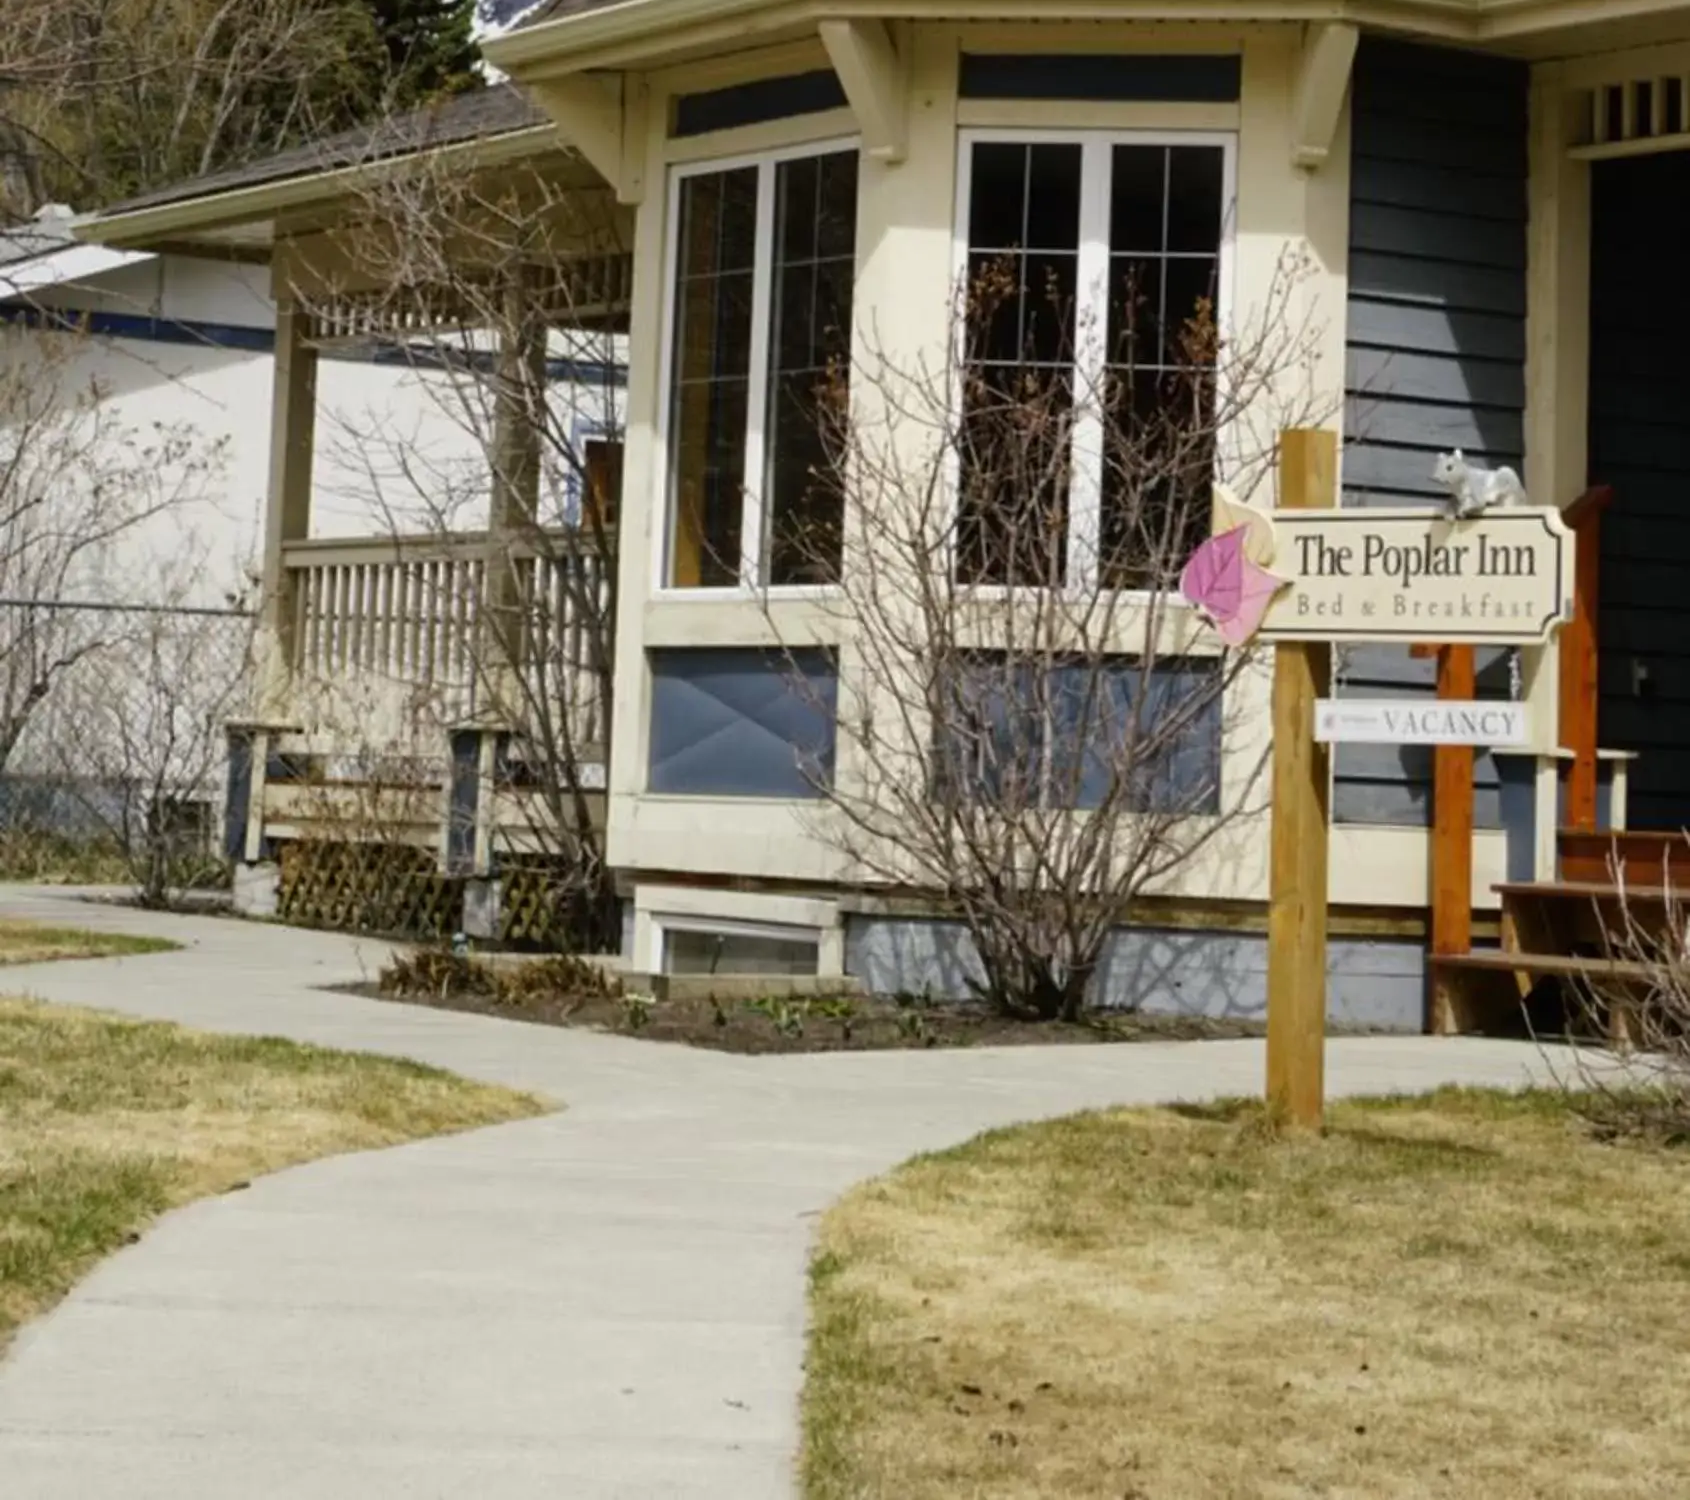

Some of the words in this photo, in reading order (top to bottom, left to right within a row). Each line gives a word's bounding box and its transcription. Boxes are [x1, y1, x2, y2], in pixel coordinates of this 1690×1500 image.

[1295, 534, 1353, 577] The
[1362, 534, 1470, 589] Poplar
[1477, 533, 1536, 577] Inn
[1297, 592, 1343, 617] Bed
[1361, 601, 1376, 617] &
[1393, 592, 1535, 618] Breakfast
[1383, 709, 1517, 738] VACANCY
